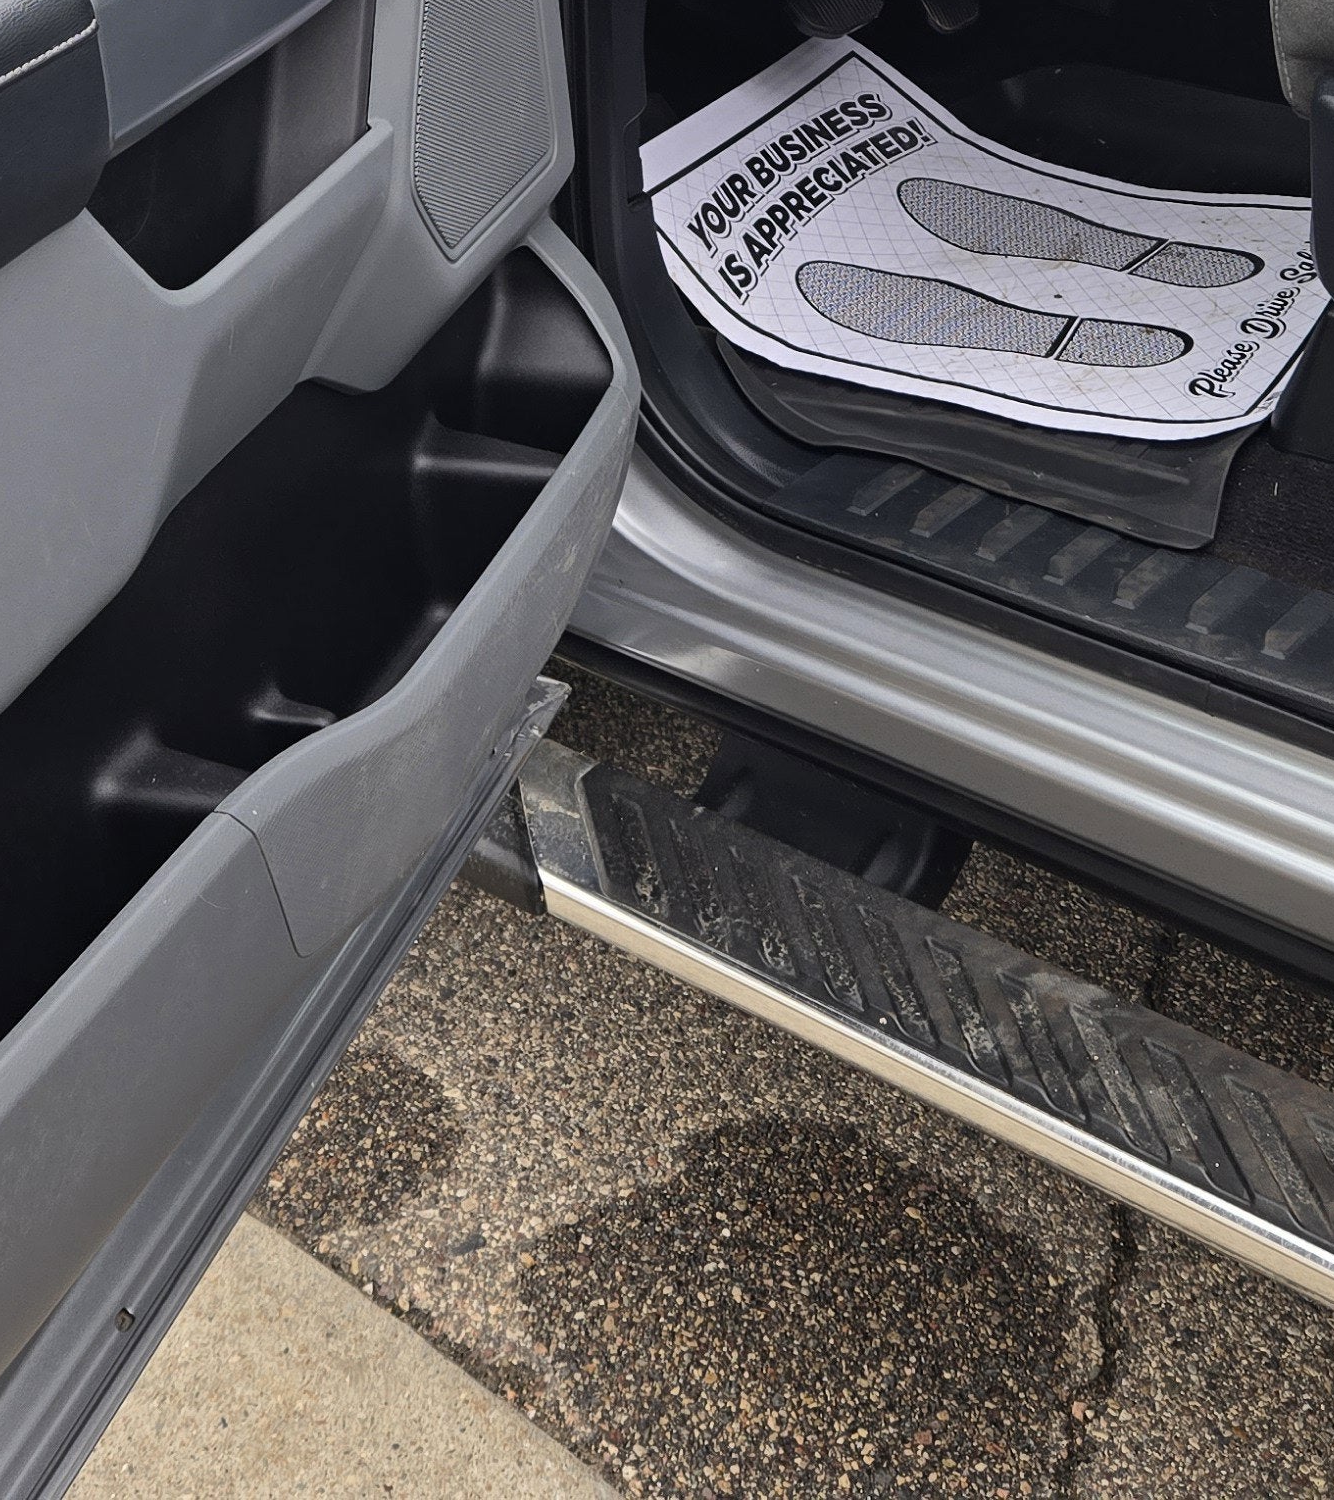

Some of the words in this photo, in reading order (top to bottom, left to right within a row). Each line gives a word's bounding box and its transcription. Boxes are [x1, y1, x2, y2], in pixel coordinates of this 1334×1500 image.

[685, 171, 759, 256] YOUR
[743, 92, 891, 194] BUSINESS
[717, 251, 756, 302] IS
[741, 118, 935, 273] APPRECIATED!
[1187, 340, 1260, 399] Please
[1240, 286, 1301, 340] Drive
